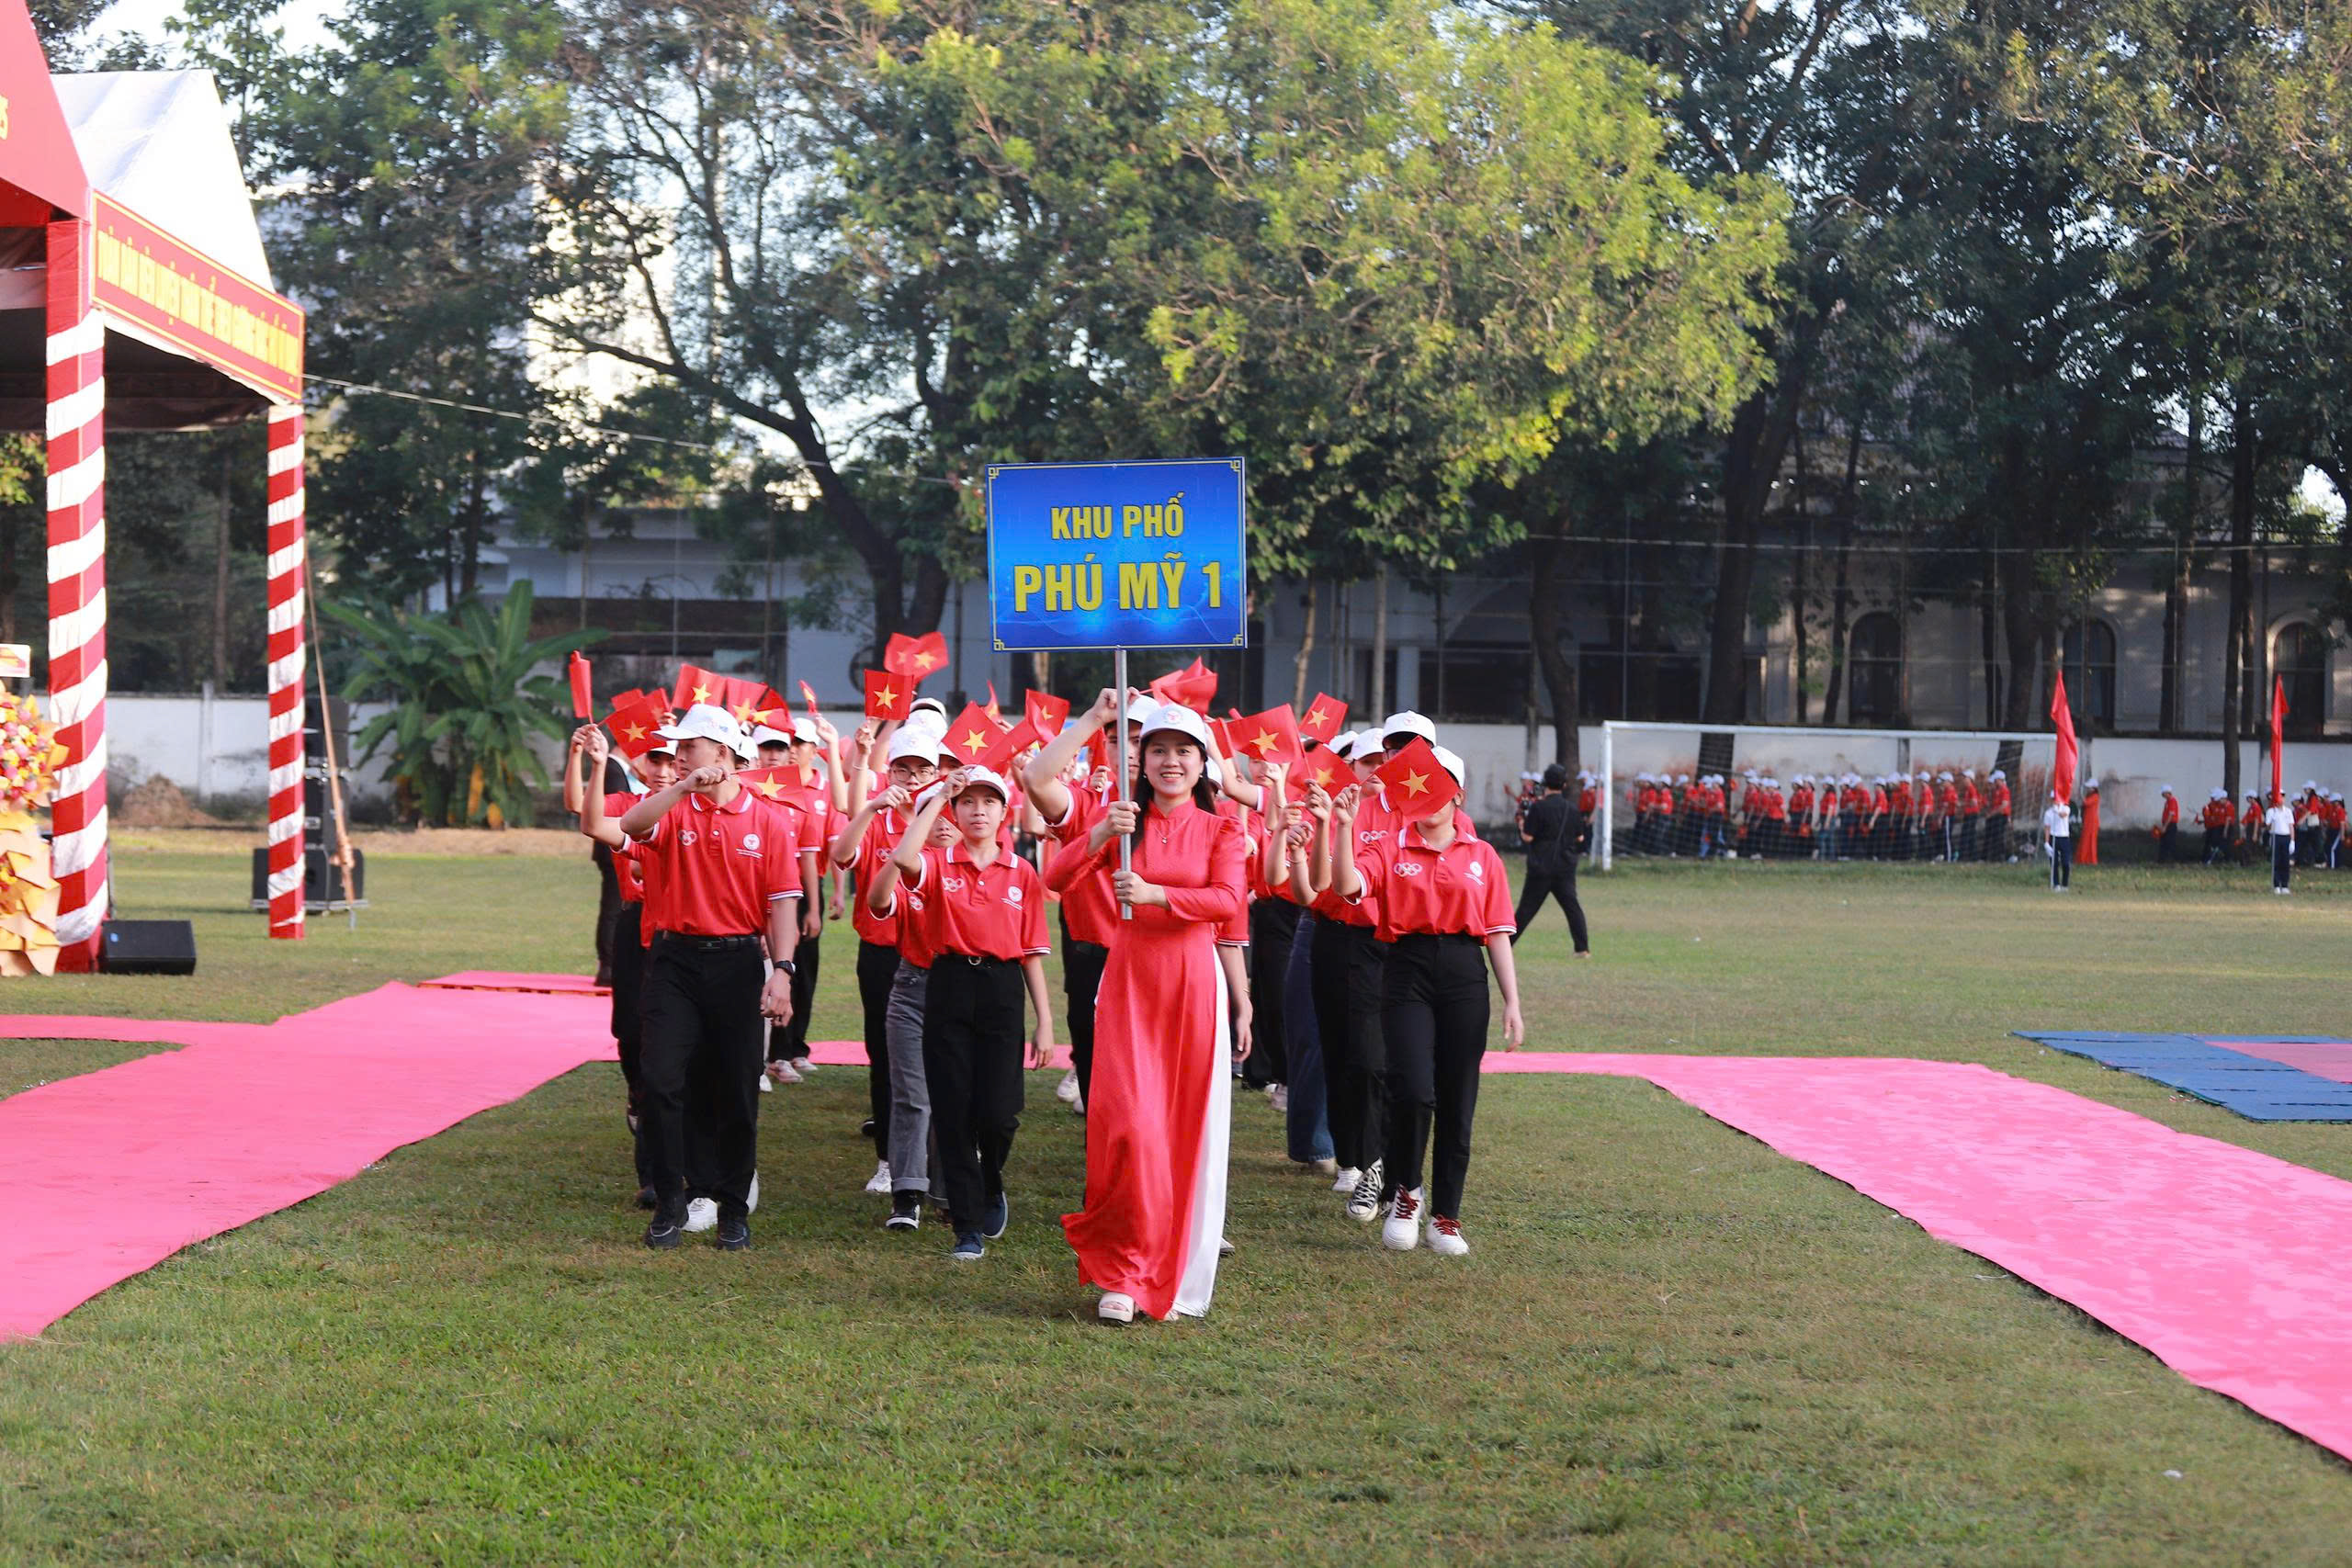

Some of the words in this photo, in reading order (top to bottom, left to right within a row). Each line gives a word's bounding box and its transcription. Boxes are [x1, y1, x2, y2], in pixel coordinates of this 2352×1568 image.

[1051, 505, 1113, 540] KHU
[1122, 491, 1186, 538] PHỐ
[1013, 553, 1102, 613] PHÚ
[1118, 551, 1187, 610] MỸ
[1202, 561, 1221, 609] 1
